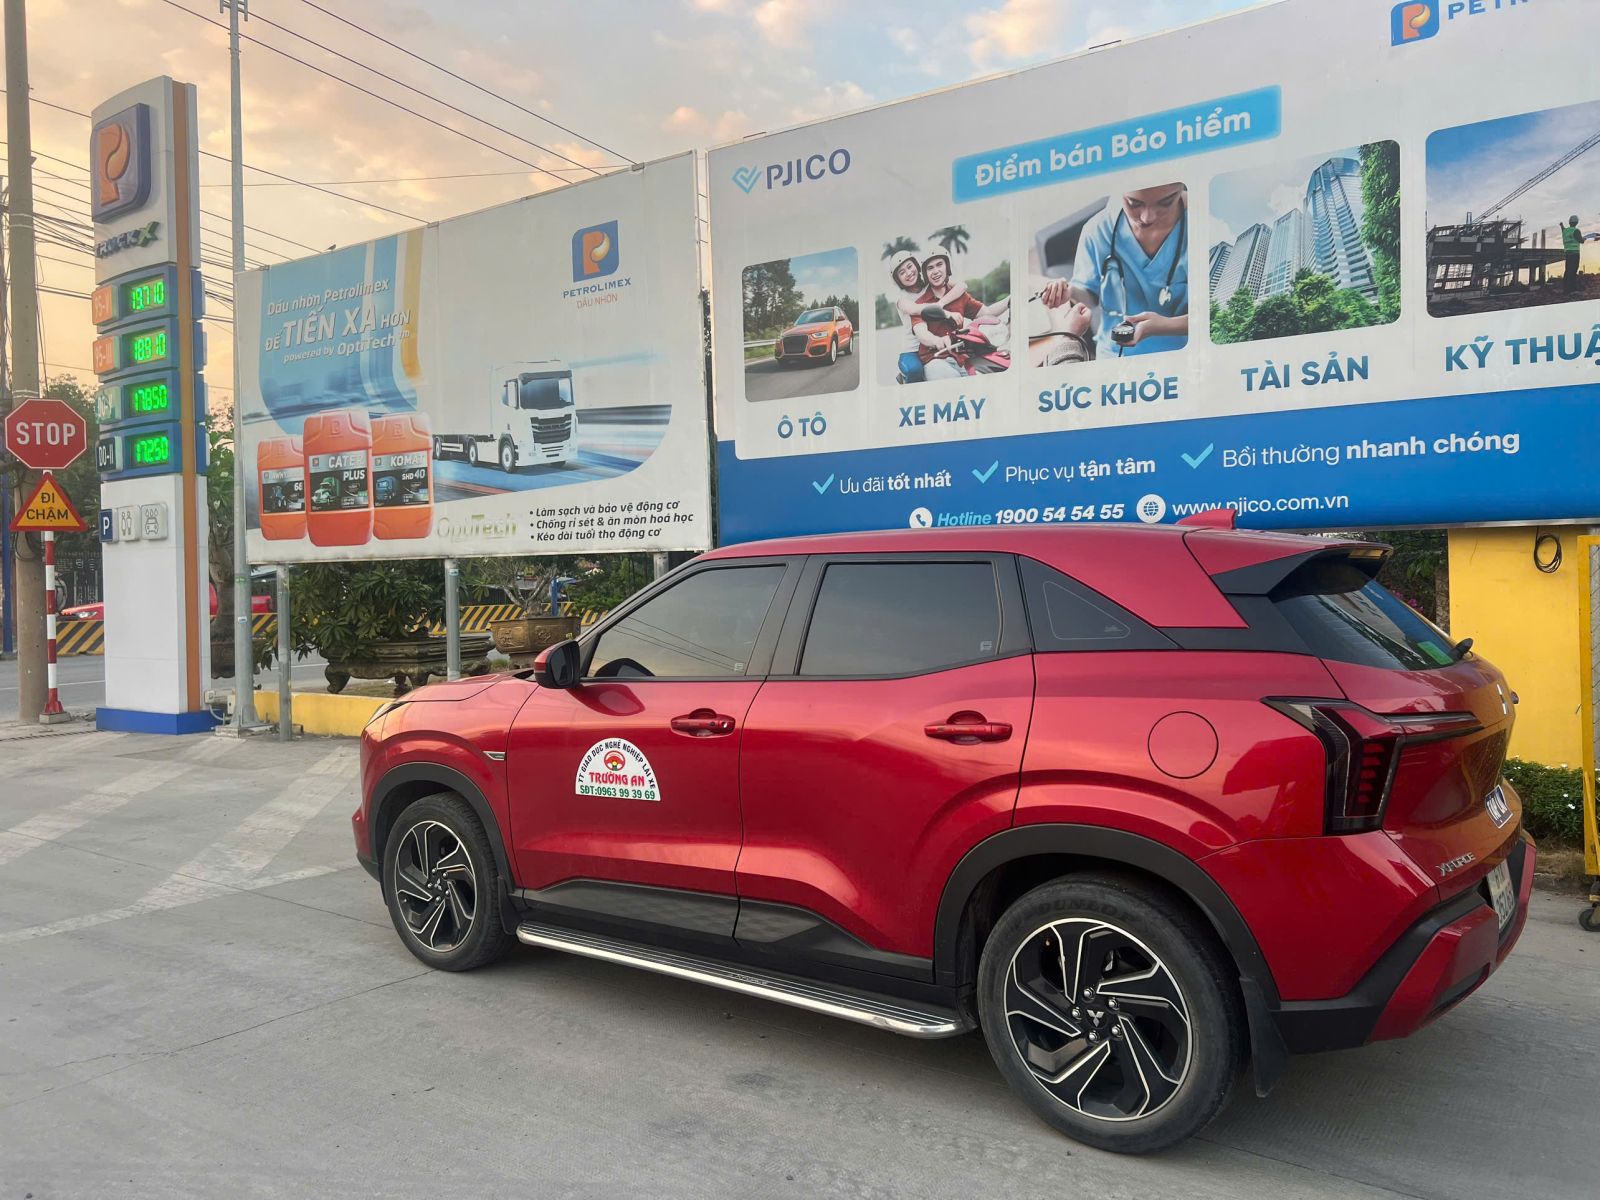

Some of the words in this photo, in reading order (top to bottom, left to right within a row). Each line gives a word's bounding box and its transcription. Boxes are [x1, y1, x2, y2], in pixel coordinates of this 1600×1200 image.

[1448, 0, 1528, 20] PE
[975, 153, 1042, 187] Điểm
[1049, 143, 1102, 171] bán
[1111, 128, 1167, 158] Bảo
[1176, 107, 1251, 144] hiểm
[766, 148, 851, 190] PJICO
[324, 279, 390, 303] Petrolimex
[563, 278, 631, 299] PETROLIMEX
[283, 305, 336, 348] TIẾN
[342, 304, 376, 338] XA
[283, 349, 321, 364] powered
[323, 346, 335, 357] by
[1445, 335, 1494, 372] KỸ
[1240, 359, 1290, 392] TÀI
[1301, 351, 1369, 386] SẢN
[1038, 383, 1092, 413] SỨC
[1101, 372, 1179, 406] KHỎE
[899, 405, 926, 428] XE
[933, 395, 986, 423] MÁY
[16, 422, 76, 446] STOP
[777, 415, 793, 439] Ô
[798, 411, 827, 437] TÔ
[1223, 446, 1256, 468] Bồi
[1261, 444, 1340, 466] thường
[1346, 436, 1425, 460] nhanh
[1433, 431, 1520, 455] chóng
[343, 470, 365, 481] PLUS
[414, 469, 426, 479] 40
[840, 478, 859, 494] Ưu
[862, 476, 885, 492] đãi
[887, 473, 911, 490] tốt
[914, 469, 951, 489] nhất
[1005, 465, 1049, 484] Phục
[1053, 465, 1074, 483] vụ
[1079, 460, 1111, 481] tận
[1117, 457, 1156, 475] tâm
[41, 491, 55, 504] ĐI
[536, 507, 556, 517] Làm
[558, 506, 581, 517] sạch
[583, 505, 596, 514] và
[598, 502, 617, 514] bảo
[620, 502, 634, 513] vệ
[636, 501, 663, 513] động
[666, 500, 681, 510] cơ
[1172, 495, 1349, 516] wwwpjico.com.vn
[26, 506, 69, 523] CHẬM
[103, 516, 111, 535] P
[536, 518, 566, 530] Chống
[578, 517, 595, 527] sét
[597, 517, 605, 526] &
[607, 517, 620, 526] ăn
[623, 515, 647, 525] mòn
[649, 513, 671, 524] hoá
[673, 513, 694, 524] học
[937, 512, 991, 526] Hotline
[995, 507, 1039, 524] 1900
[1042, 506, 1066, 522] 54
[1071, 505, 1095, 521] 54
[1100, 504, 1125, 519] 55
[537, 532, 555, 541] Kéo
[557, 531, 573, 540] dài
[575, 528, 596, 540] tuổi
[598, 530, 616, 540] thọ
[618, 528, 645, 540] động
[648, 528, 662, 537] cơ
[578, 773, 585, 783] TT
[592, 744, 604, 757] DỤC
[622, 743, 644, 763] NGHIỆP
[642, 763, 651, 777] LÁI
[648, 777, 656, 789] XE
[589, 771, 628, 785] TRƯỜNG
[631, 775, 645, 786] AN
[620, 788, 629, 798] 99
[632, 790, 642, 799] 39
[645, 791, 655, 799] 69
